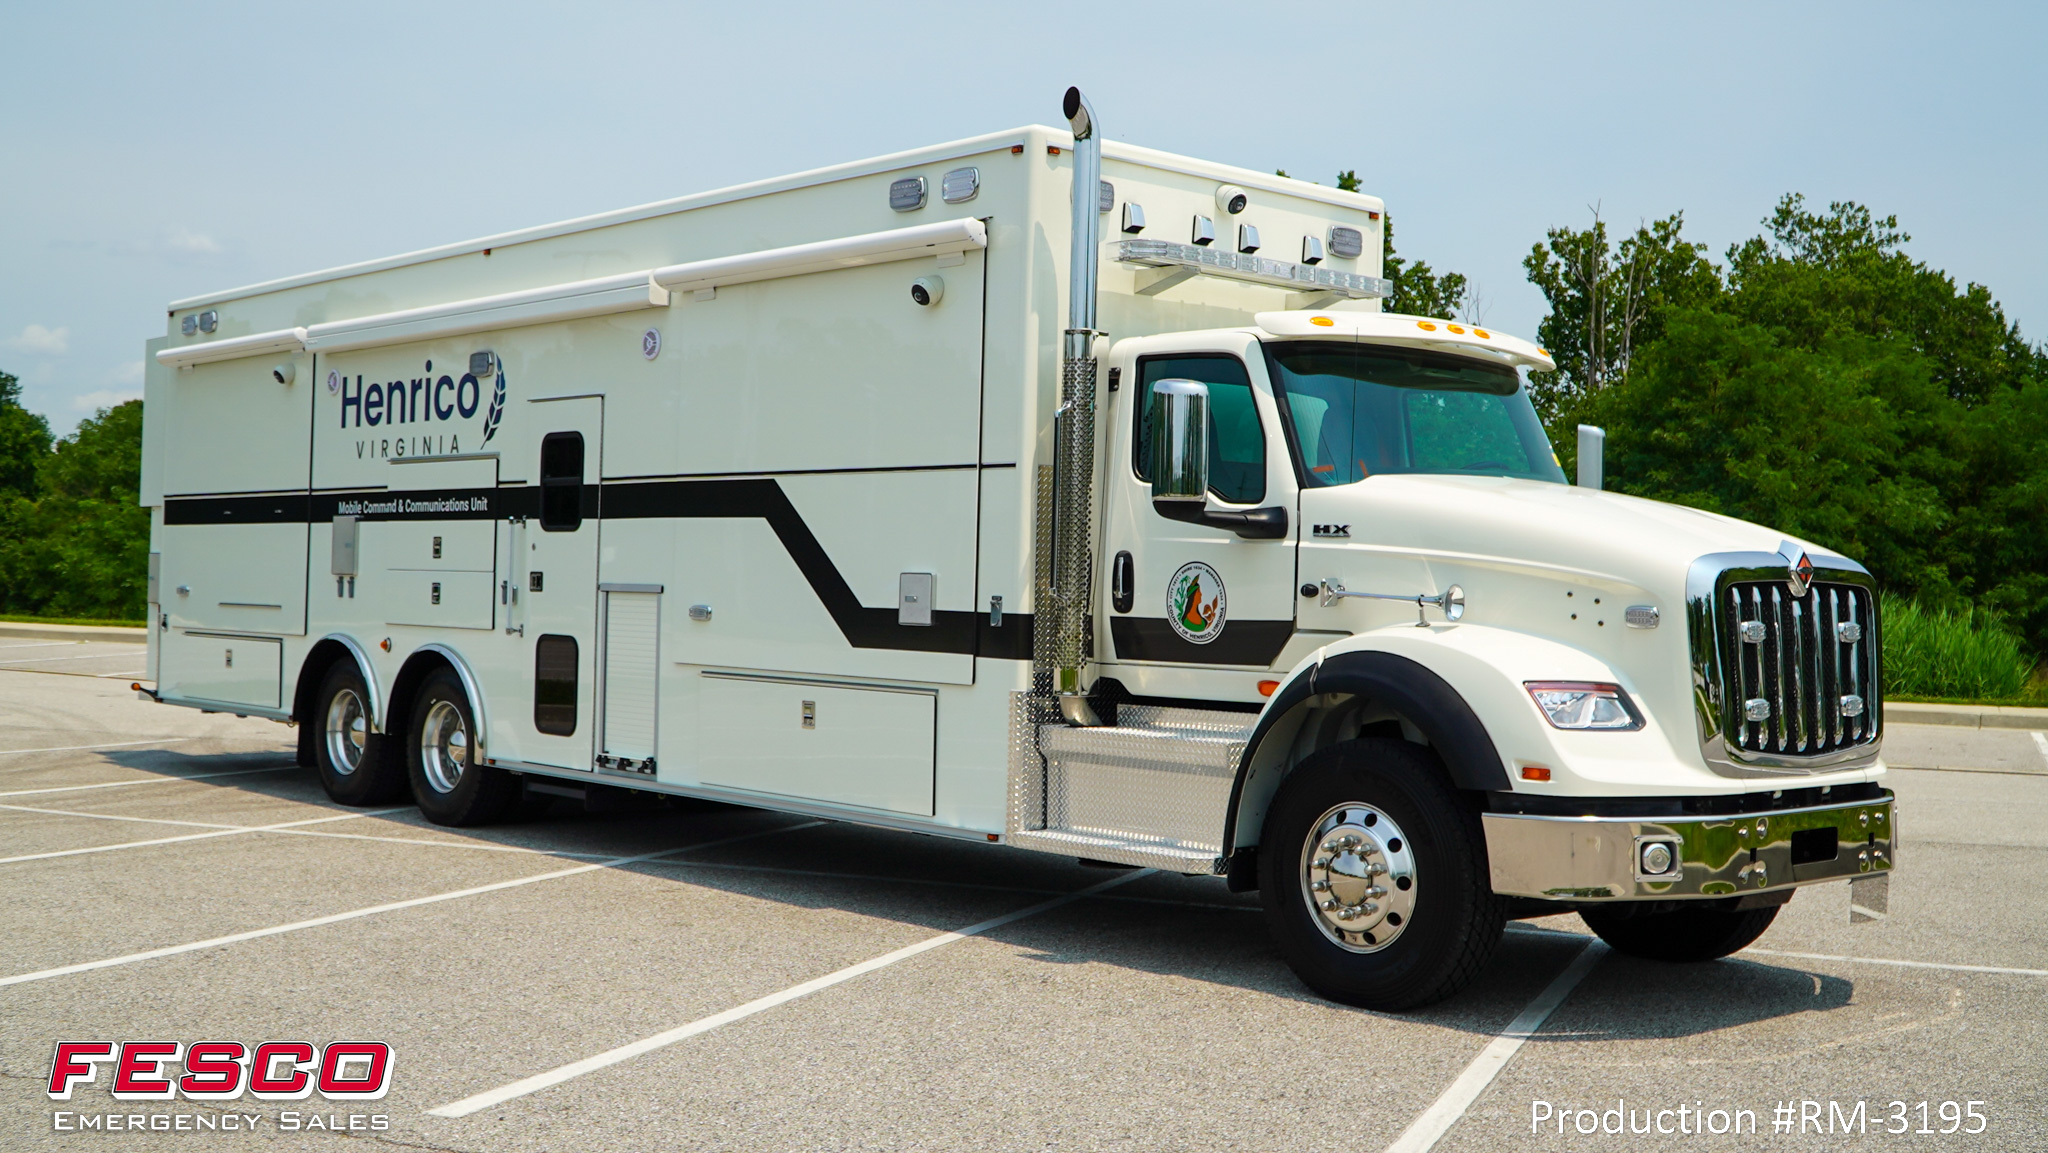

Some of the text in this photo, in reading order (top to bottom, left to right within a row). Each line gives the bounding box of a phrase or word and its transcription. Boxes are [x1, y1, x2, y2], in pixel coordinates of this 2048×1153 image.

[341, 360, 480, 429] Henrico
[356, 434, 460, 459] VIRGINIA
[338, 501, 362, 514] Mobile
[398, 499, 404, 513] &
[405, 497, 469, 513] Communications
[470, 496, 488, 511] Unit
[1313, 524, 1351, 535] HX
